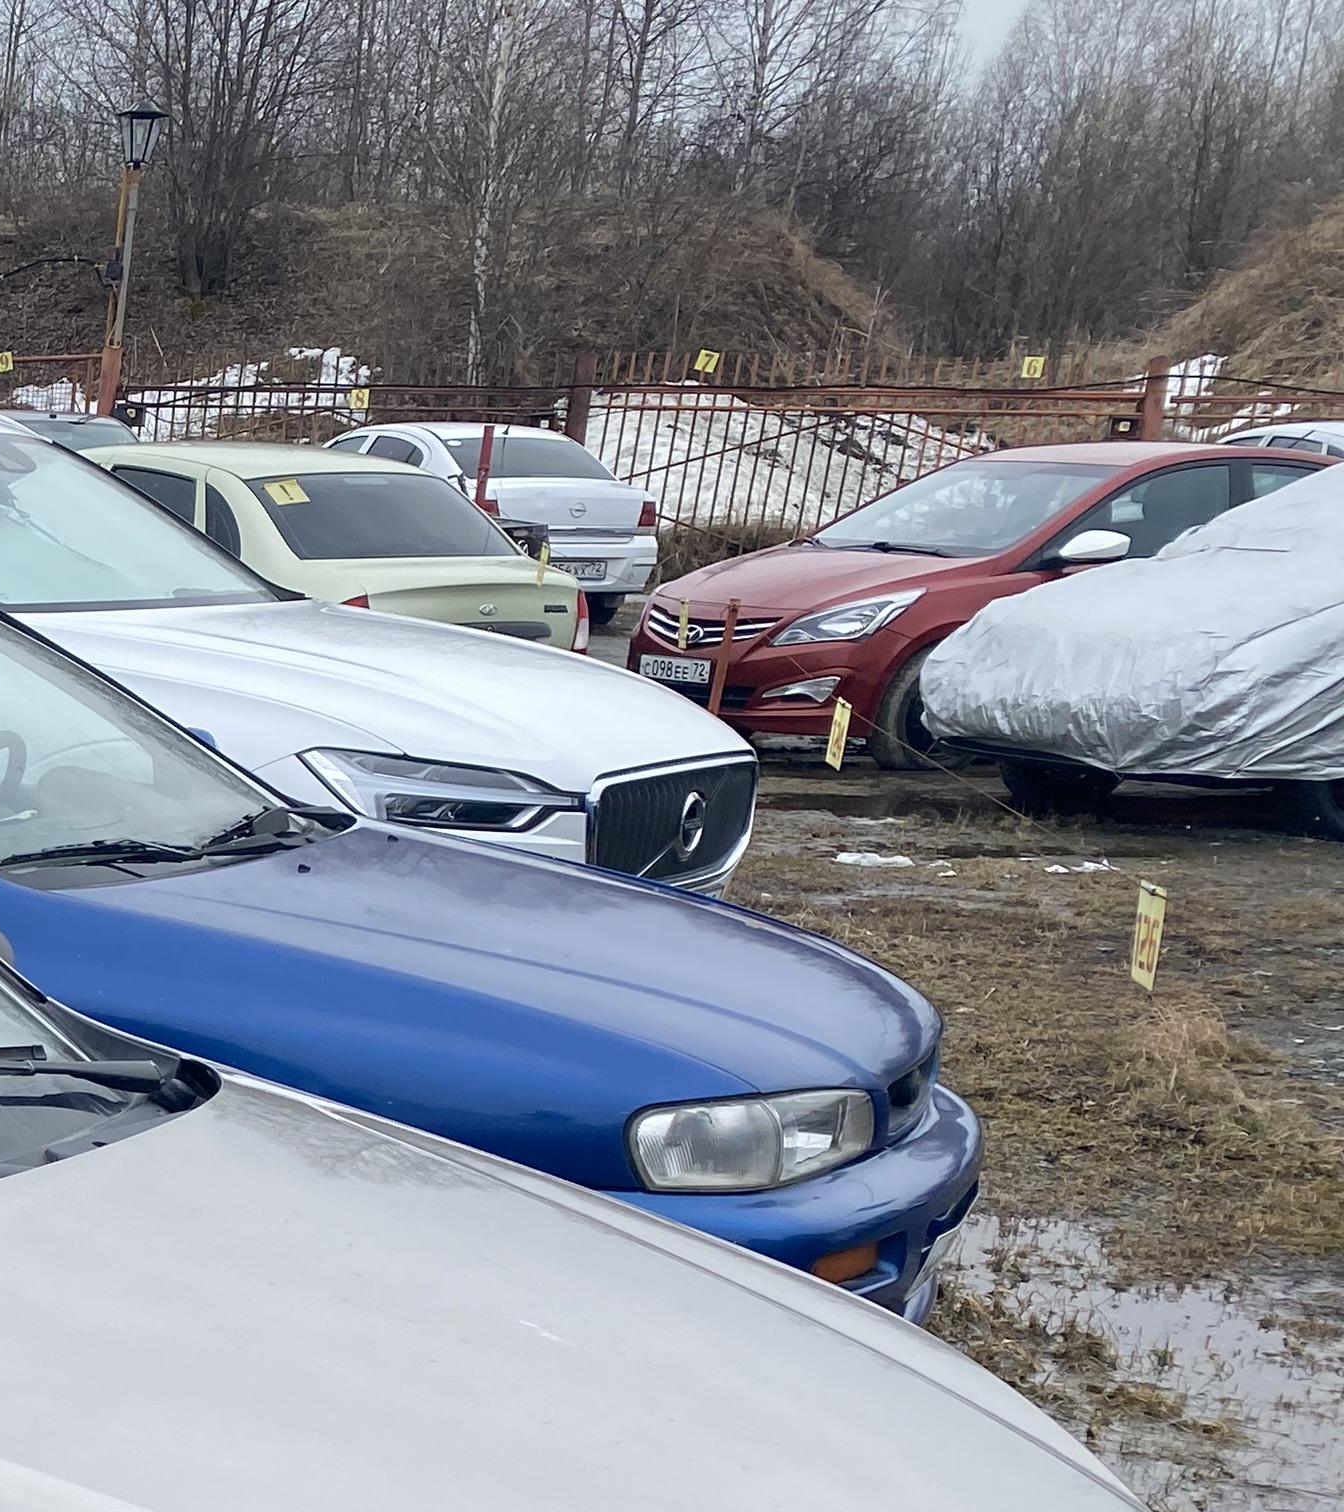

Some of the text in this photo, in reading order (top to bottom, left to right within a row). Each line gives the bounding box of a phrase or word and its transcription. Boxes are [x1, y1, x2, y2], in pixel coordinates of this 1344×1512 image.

[0, 354, 9, 370] 9
[701, 353, 714, 371] 7
[1027, 359, 1038, 376] 6
[355, 390, 365, 408] 8
